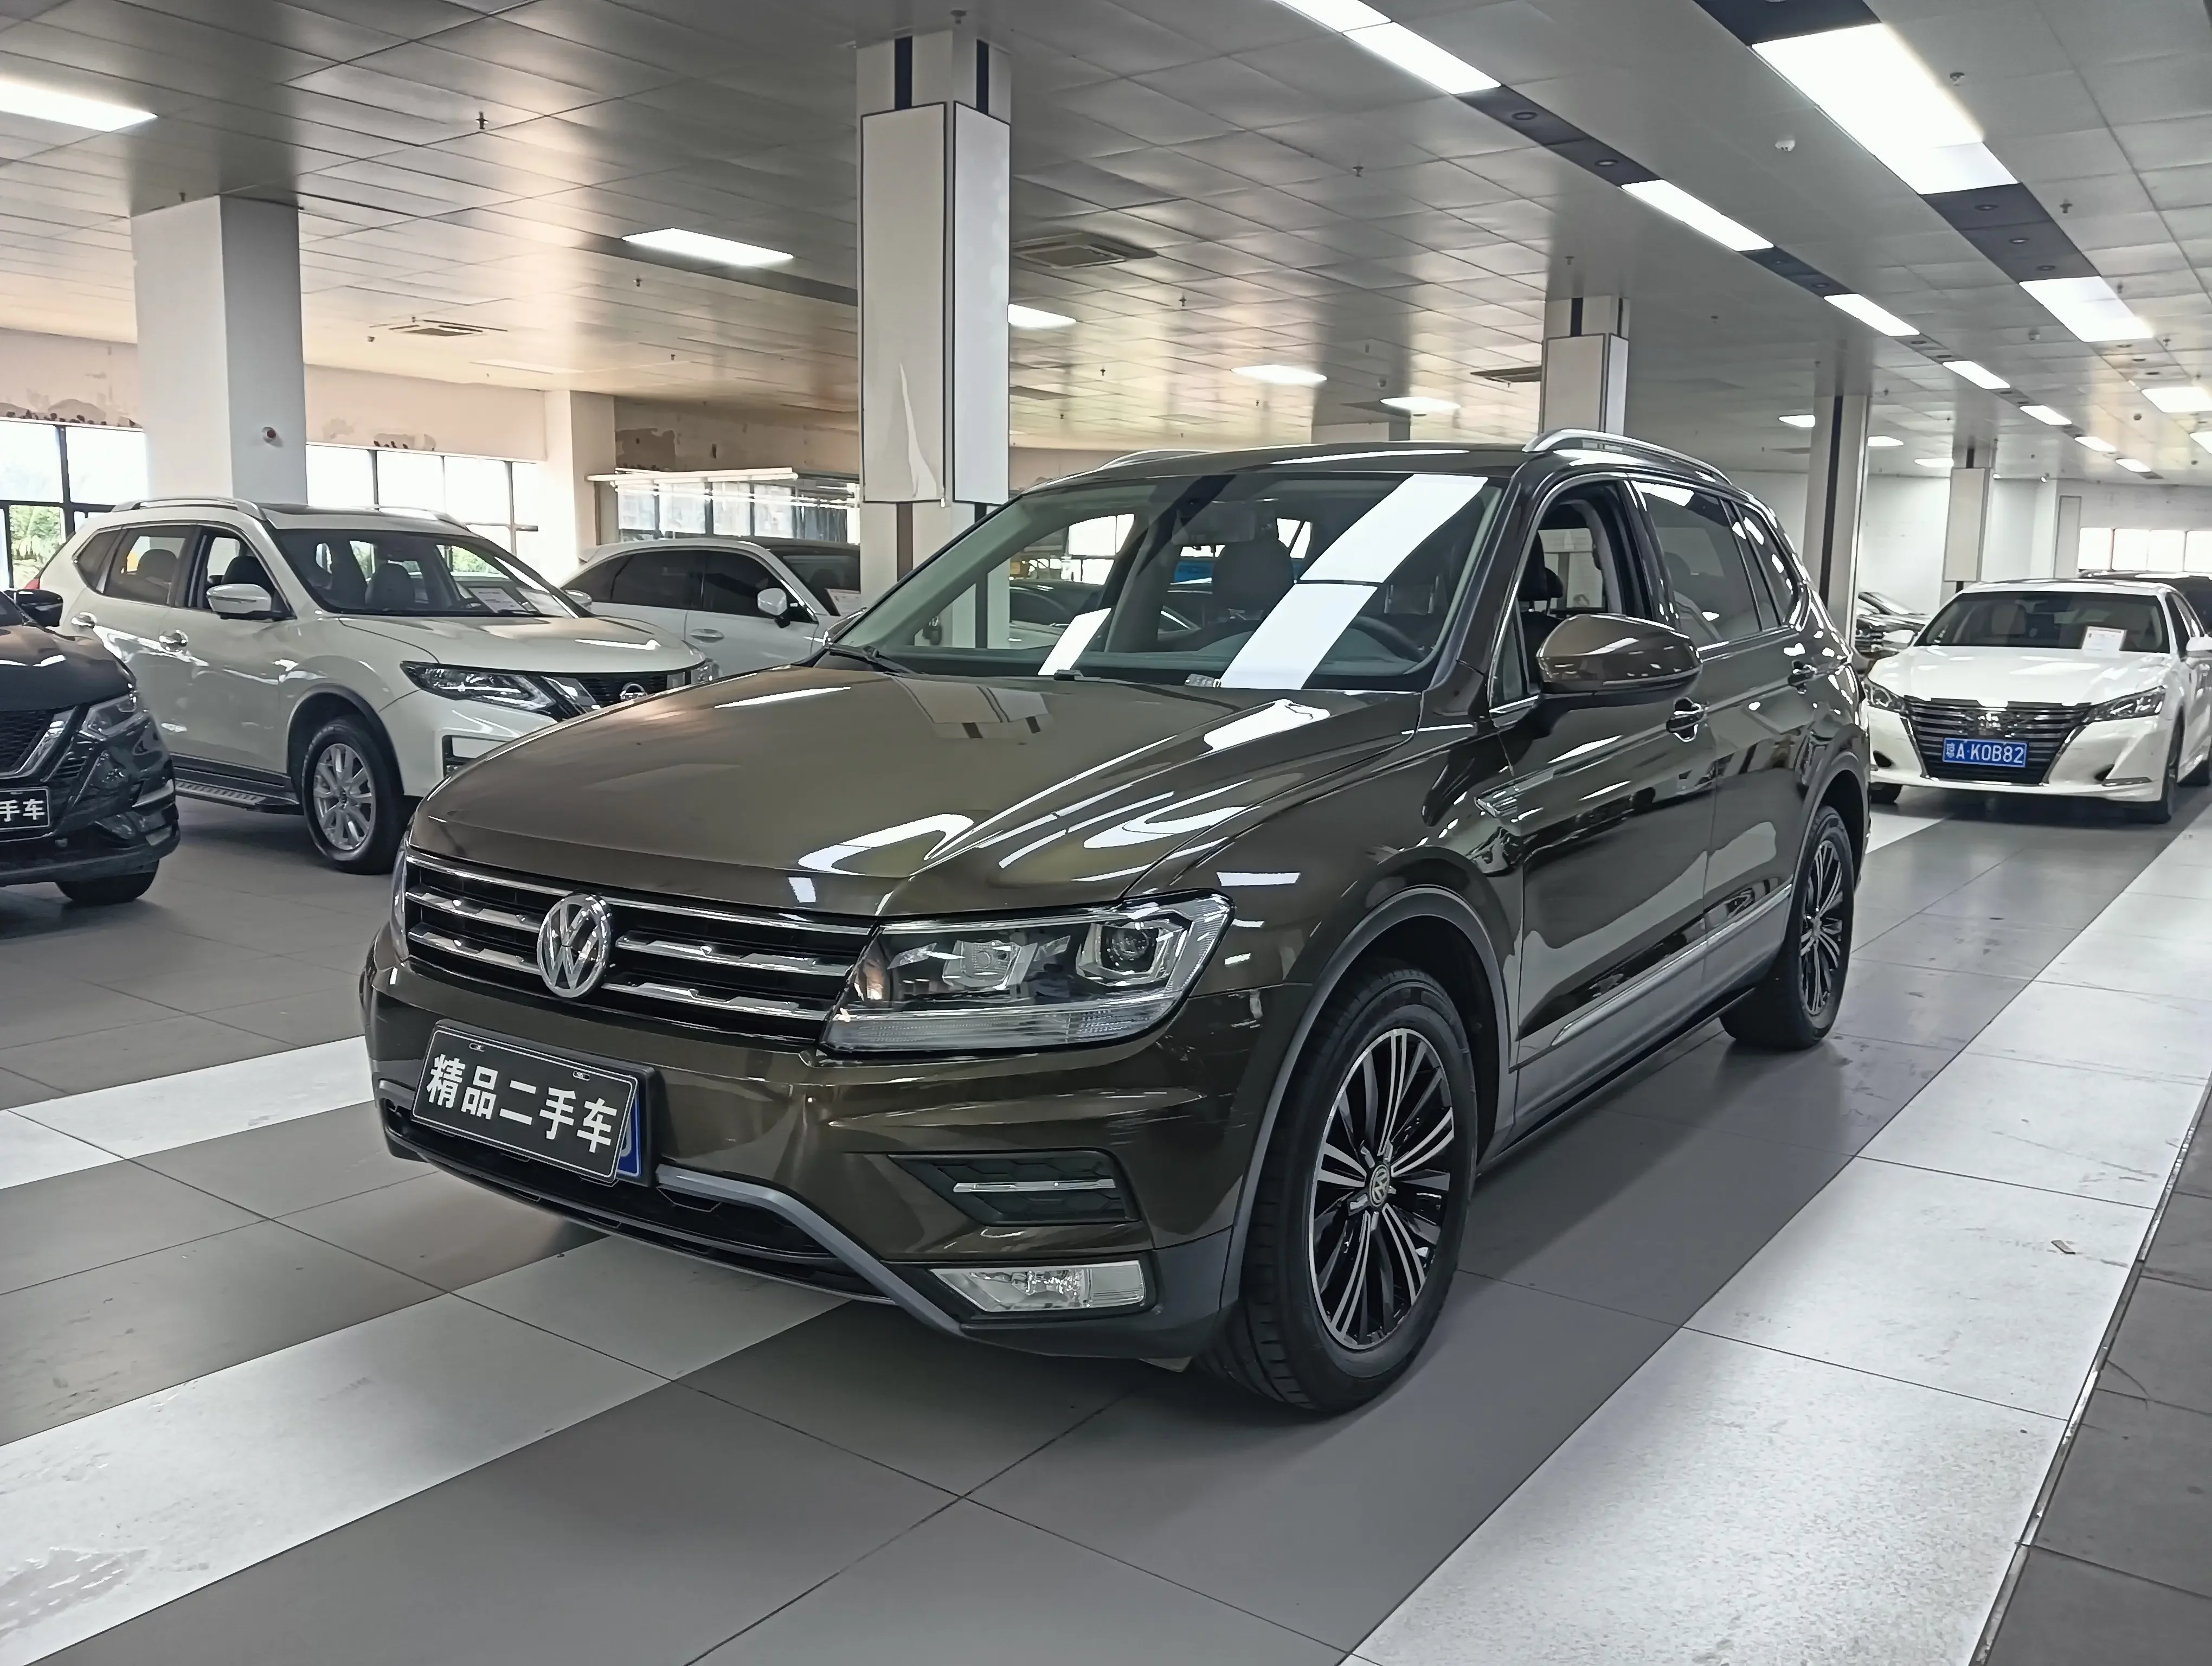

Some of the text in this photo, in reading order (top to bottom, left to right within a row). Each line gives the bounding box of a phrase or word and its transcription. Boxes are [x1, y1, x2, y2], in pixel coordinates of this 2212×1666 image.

[426, 1054, 618, 1154] 精品二手车
